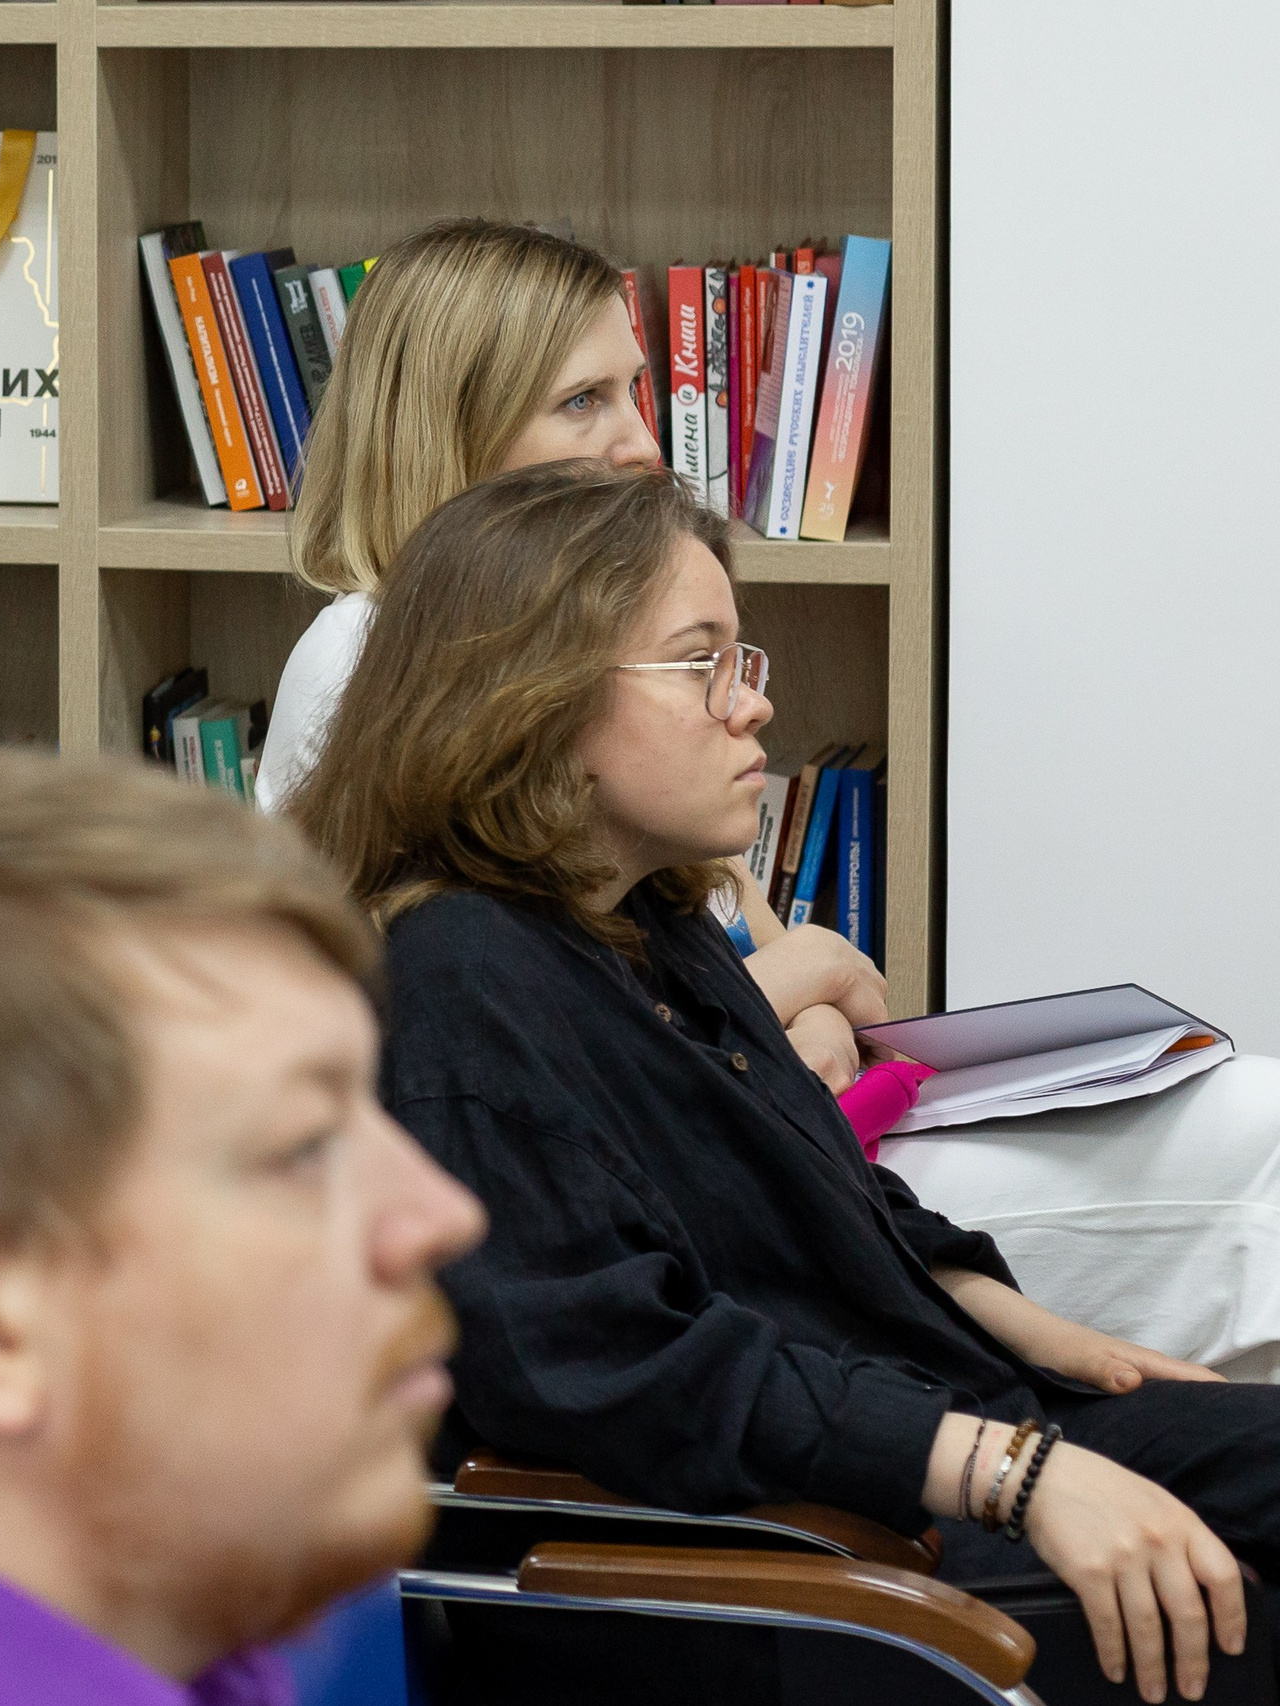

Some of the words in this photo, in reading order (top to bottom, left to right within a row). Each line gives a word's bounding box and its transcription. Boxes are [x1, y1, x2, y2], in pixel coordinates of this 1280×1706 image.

[36, 154, 58, 165] 201
[673, 303, 700, 378] Книги
[835, 311, 865, 372] 2019
[29, 428, 57, 439] 1944
[788, 390, 804, 445] РУССКИХ
